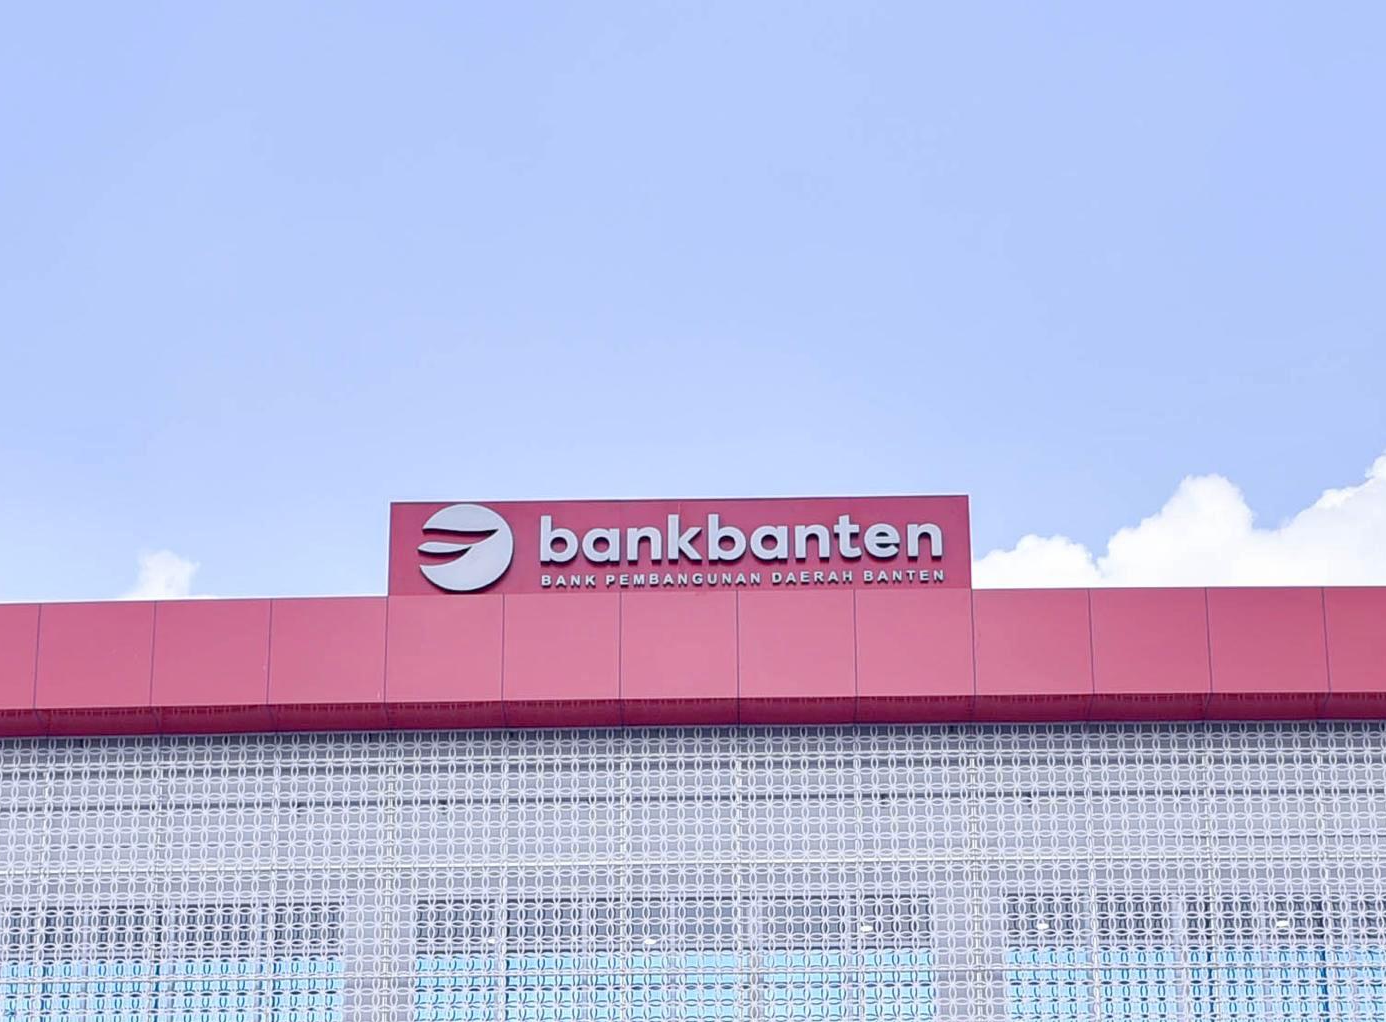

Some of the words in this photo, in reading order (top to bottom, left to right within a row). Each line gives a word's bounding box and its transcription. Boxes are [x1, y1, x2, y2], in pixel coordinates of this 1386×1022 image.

[539, 513, 944, 564] bankbanten
[541, 574, 597, 587] BANK
[605, 572, 761, 586] PEMBANGUNAN
[771, 570, 854, 584] DAERAH
[863, 569, 945, 583] BANTEN
